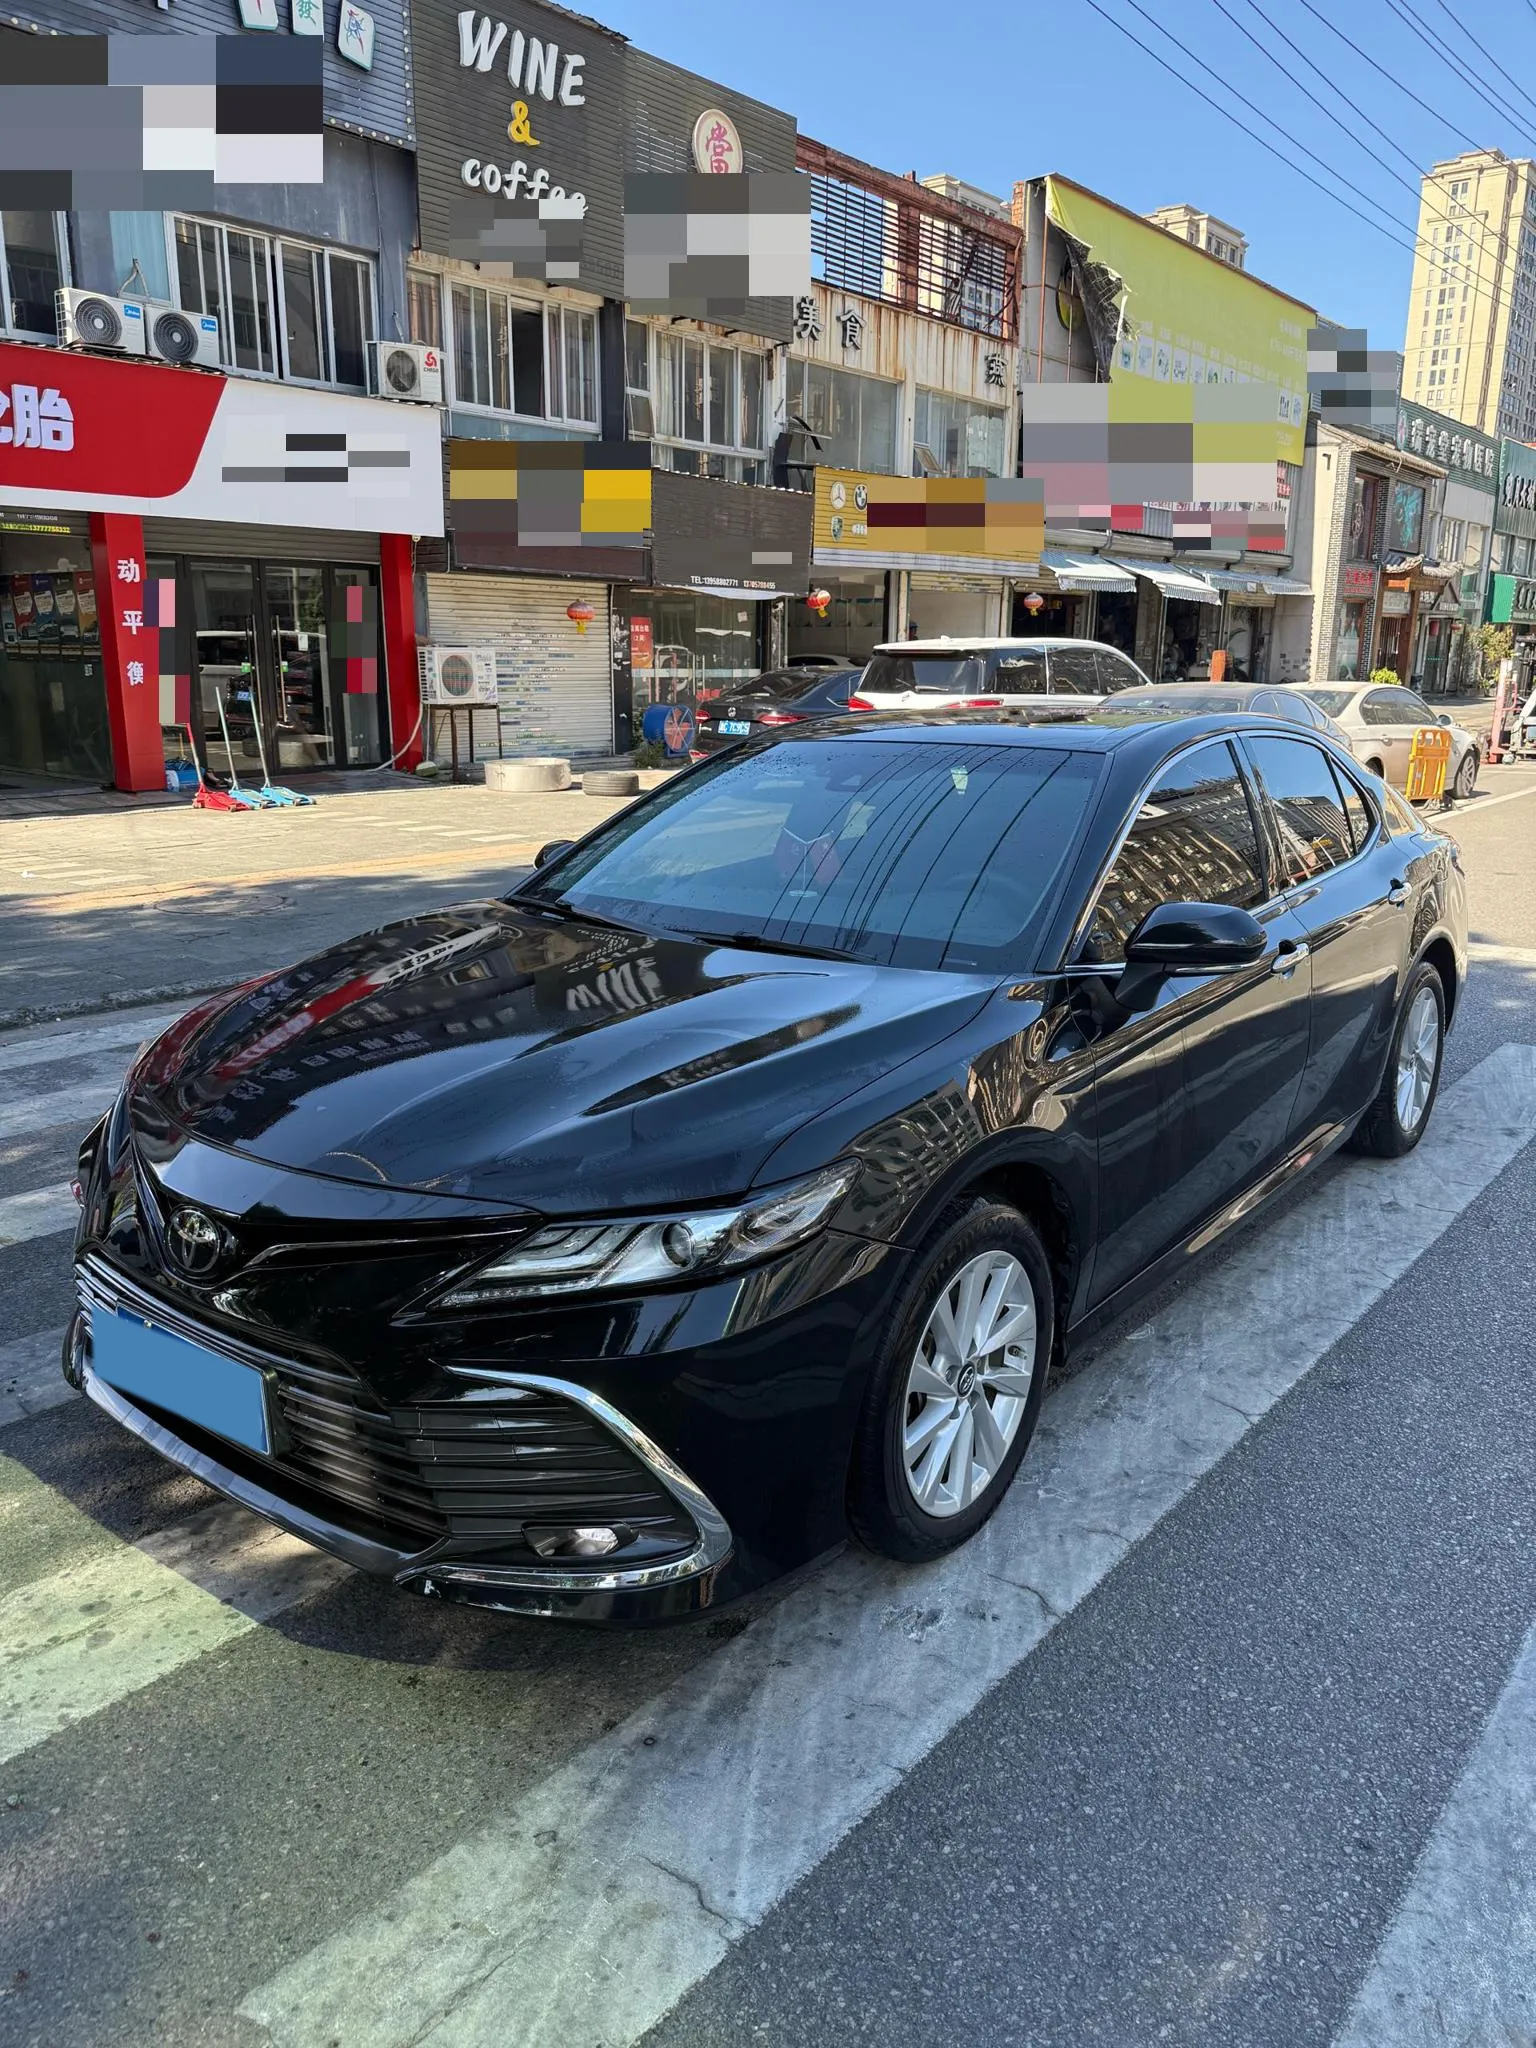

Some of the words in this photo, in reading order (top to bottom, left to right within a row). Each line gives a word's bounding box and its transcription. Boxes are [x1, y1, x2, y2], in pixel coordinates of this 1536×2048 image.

[458, 10, 586, 107] WINE
[507, 100, 540, 146] &
[794, 296, 866, 350] 美食
